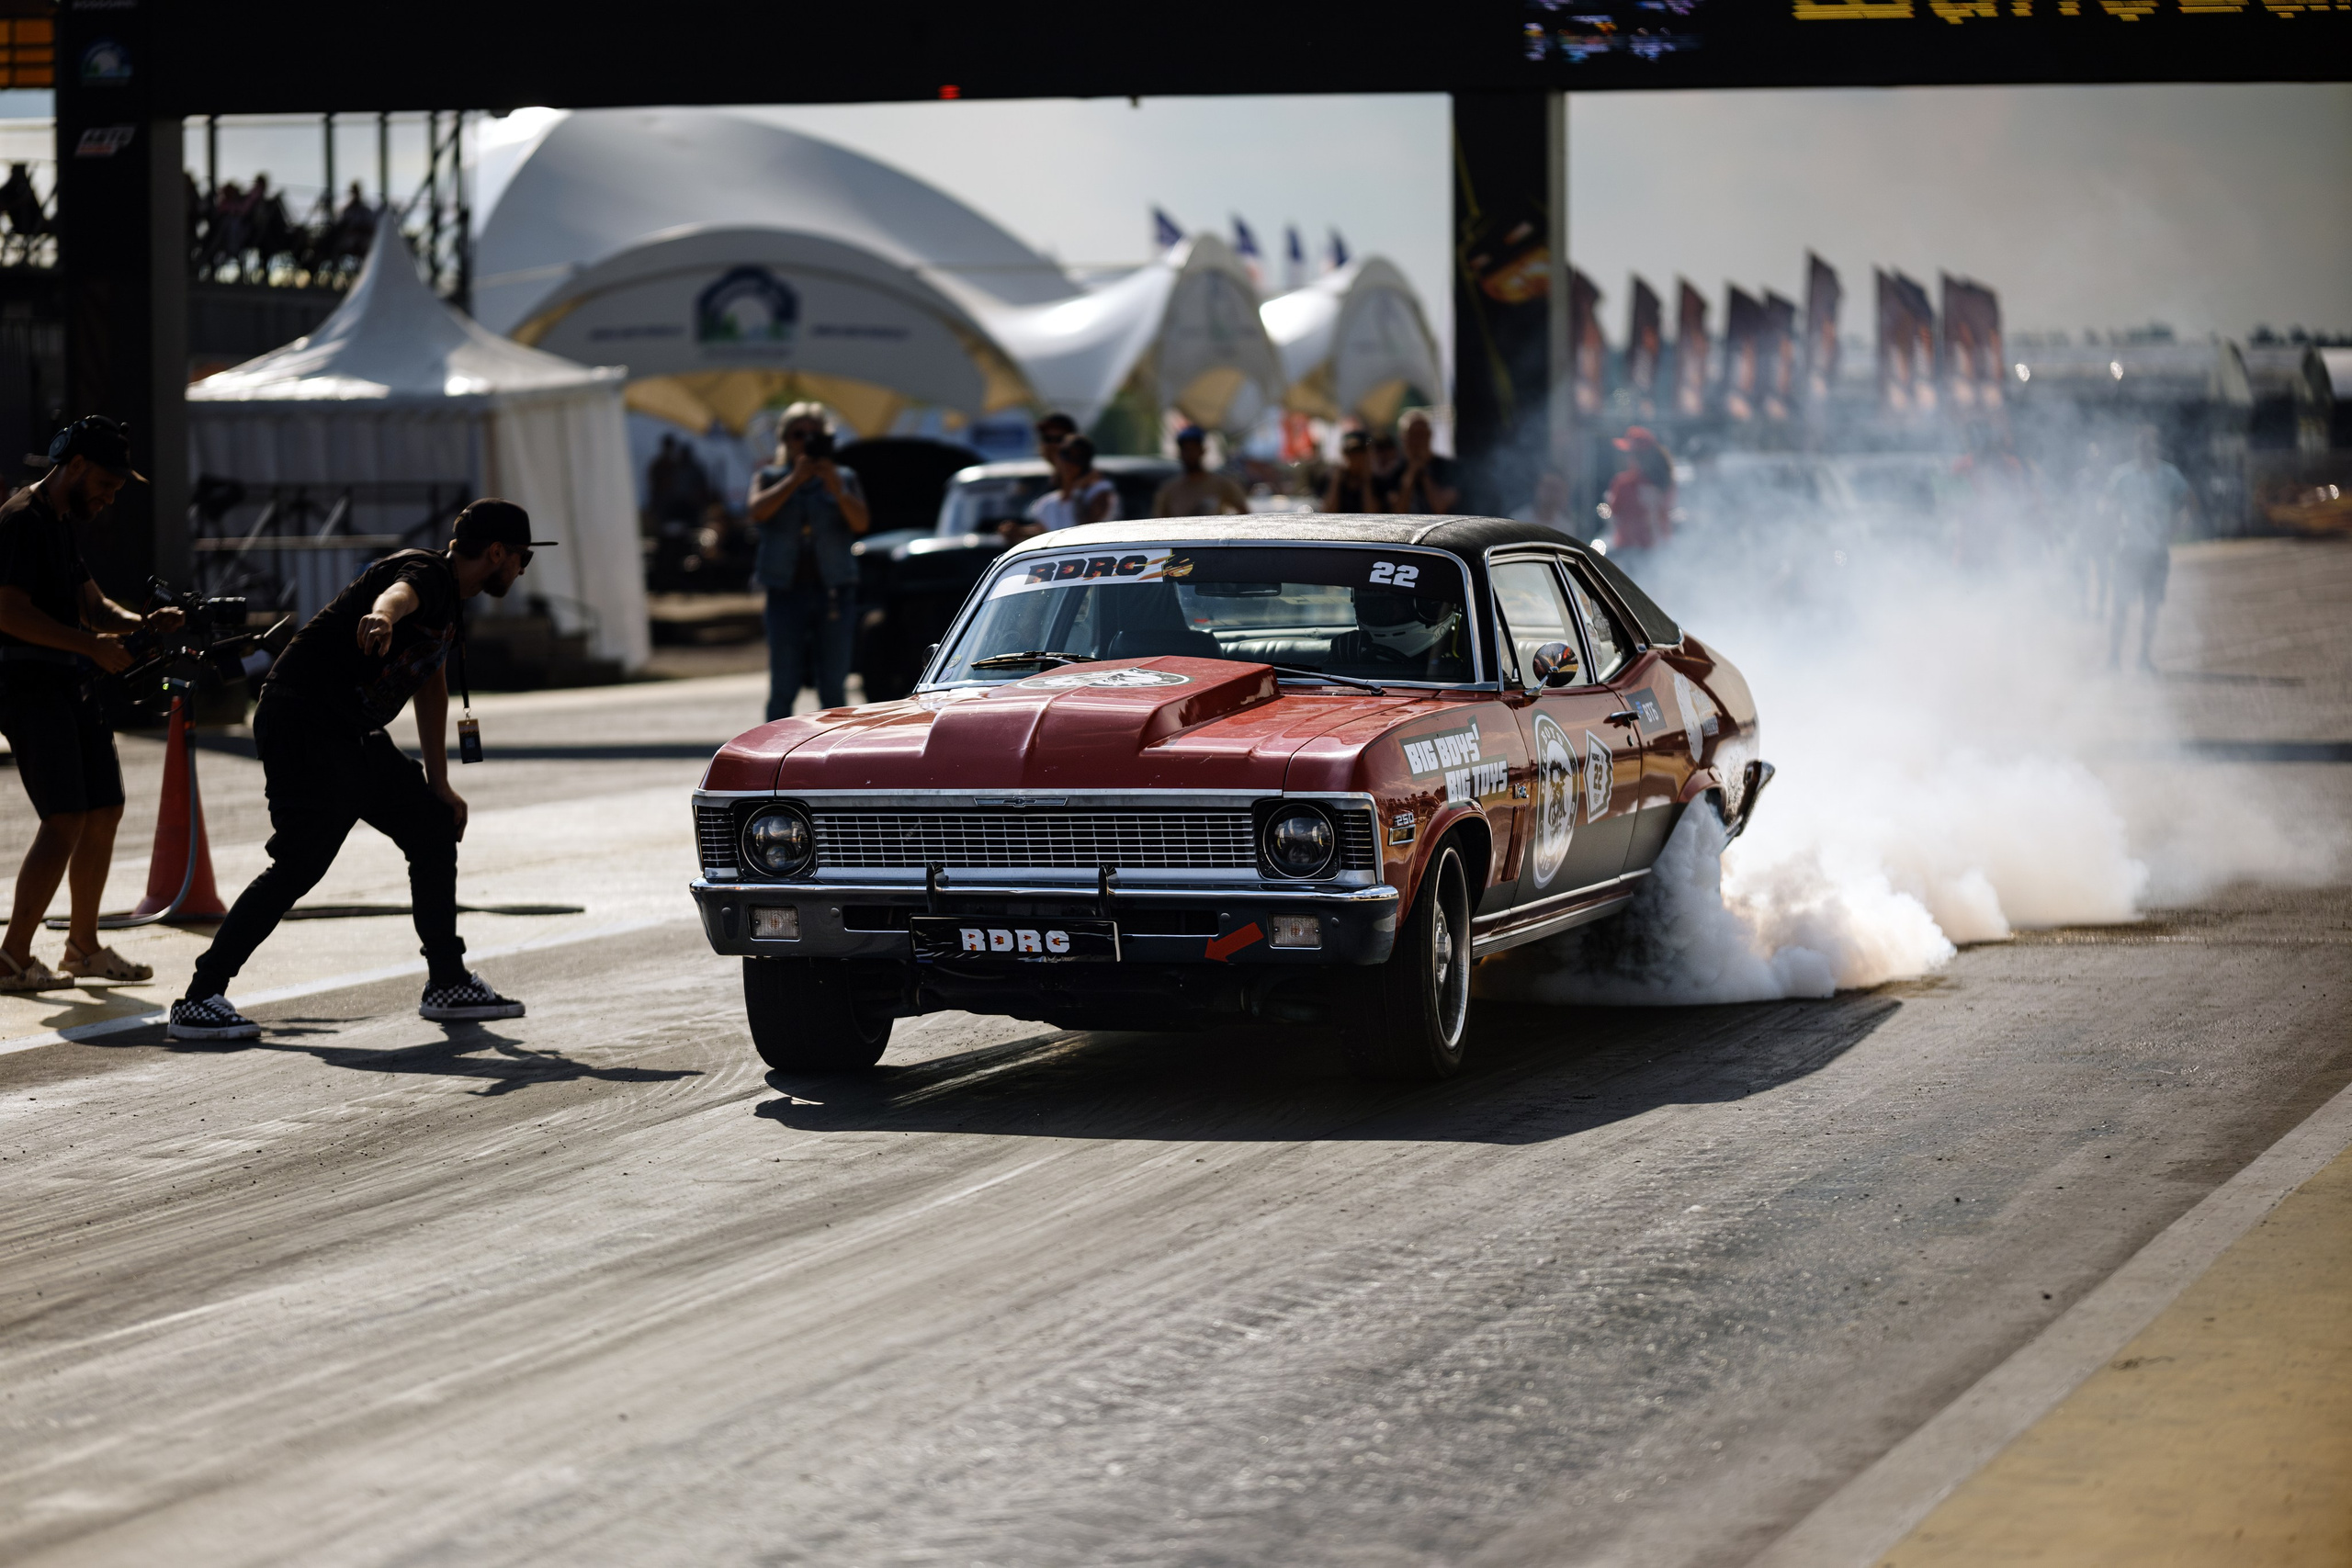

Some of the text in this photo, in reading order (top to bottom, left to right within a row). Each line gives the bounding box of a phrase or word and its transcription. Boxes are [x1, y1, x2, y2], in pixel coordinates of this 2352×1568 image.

[1024, 555, 1148, 585] RDRC
[1369, 561, 1419, 588] 22
[1404, 739, 1439, 774] BIG
[1445, 761, 1508, 804] BIG TOYS
[1593, 763, 1603, 791] 22
[1395, 812, 1415, 826] 250
[959, 929, 1070, 953] RDRC
